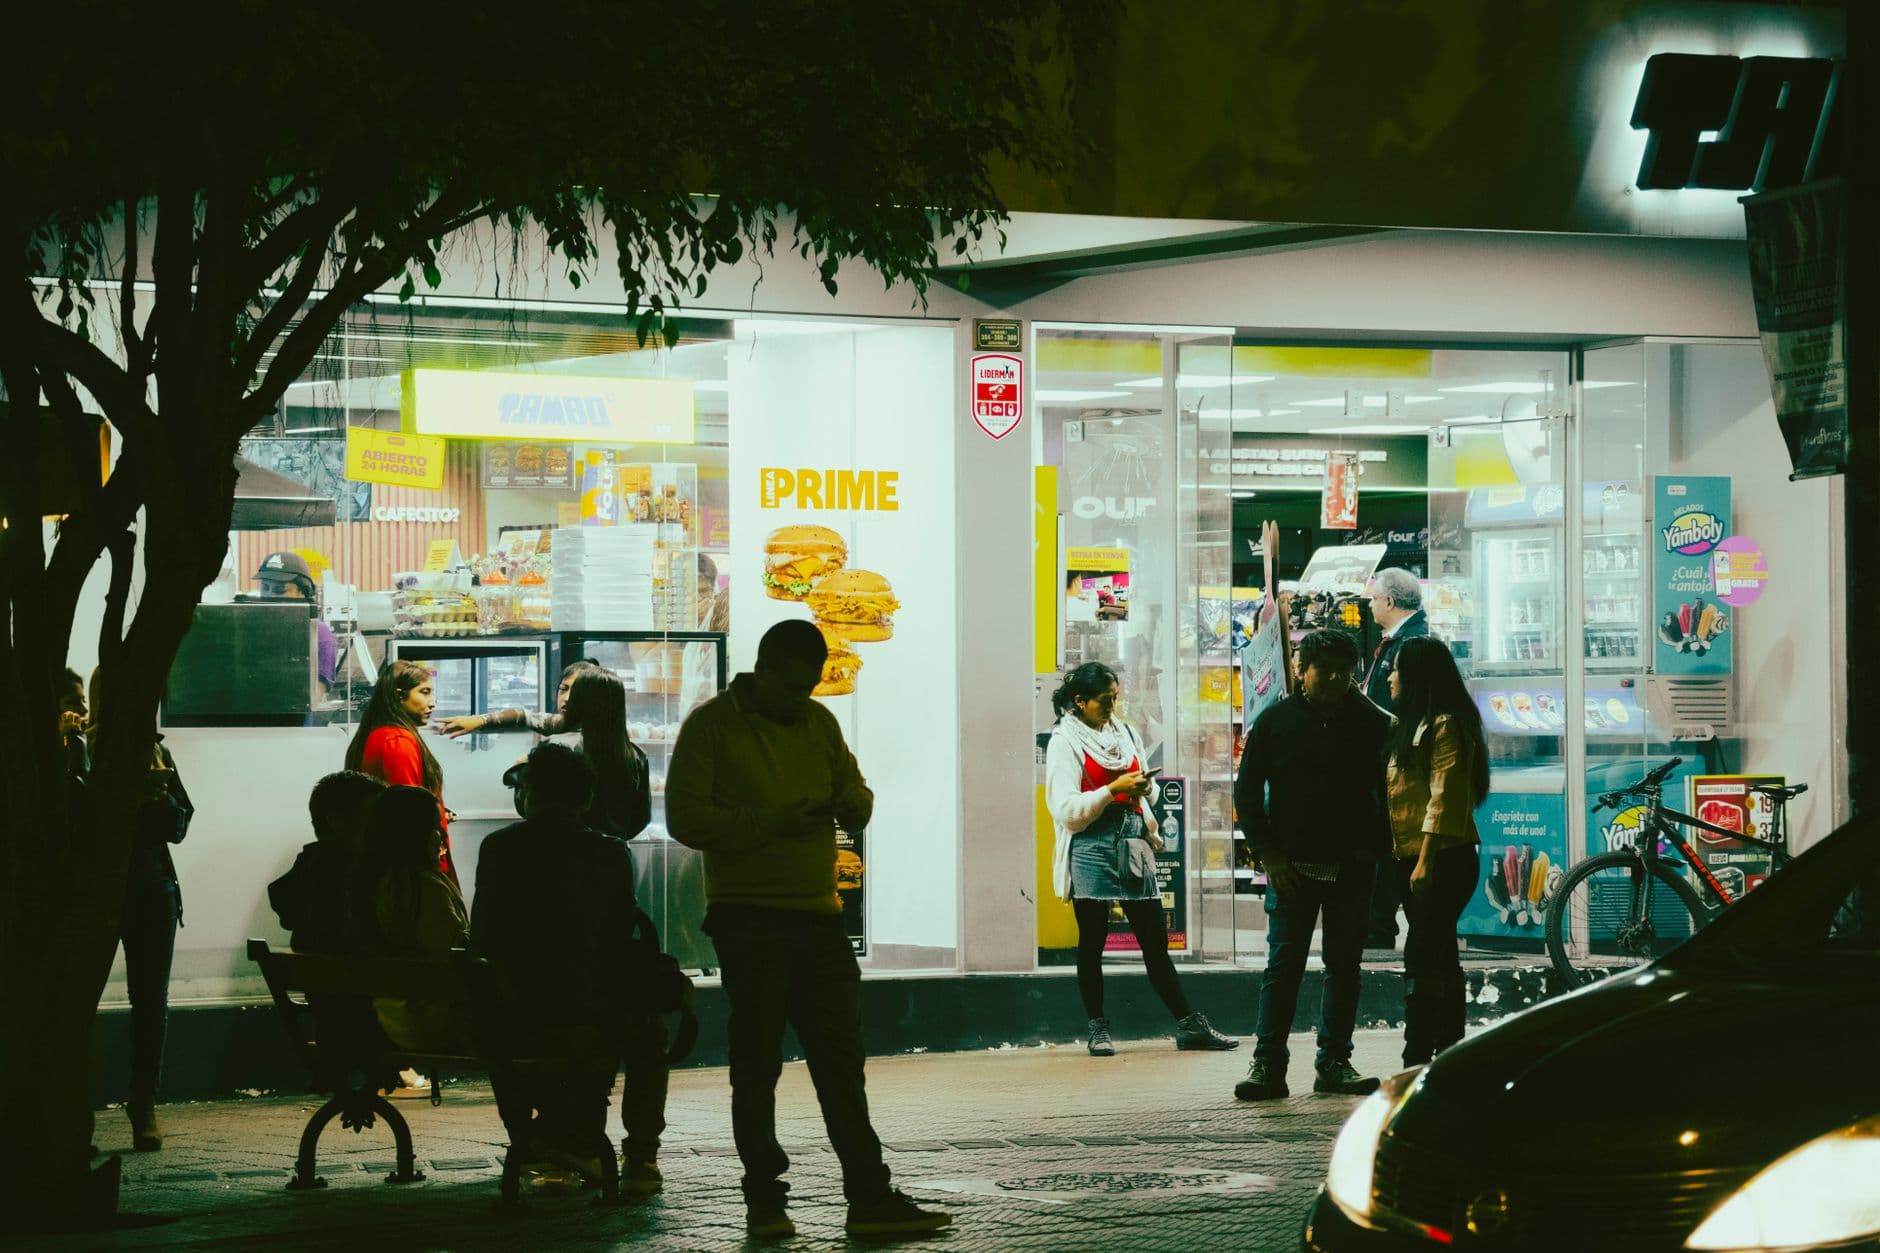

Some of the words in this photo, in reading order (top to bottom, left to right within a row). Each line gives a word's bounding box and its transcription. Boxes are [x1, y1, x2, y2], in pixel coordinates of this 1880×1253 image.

[498, 393, 610, 427] TAMBO
[362, 450, 427, 467] ABIERTO
[361, 461, 377, 471] 24
[380, 463, 427, 477] HORAS
[761, 468, 899, 511] PRIME
[375, 506, 460, 522] CAFECITO?
[1387, 530, 1415, 544] four
[1663, 514, 1723, 551] Yámboly
[1673, 566, 1704, 581] ¿Cuál
[1526, 813, 1539, 822] con
[1503, 823, 1518, 835] más
[1519, 824, 1529, 835] de
[1530, 825, 1547, 836] uno!
